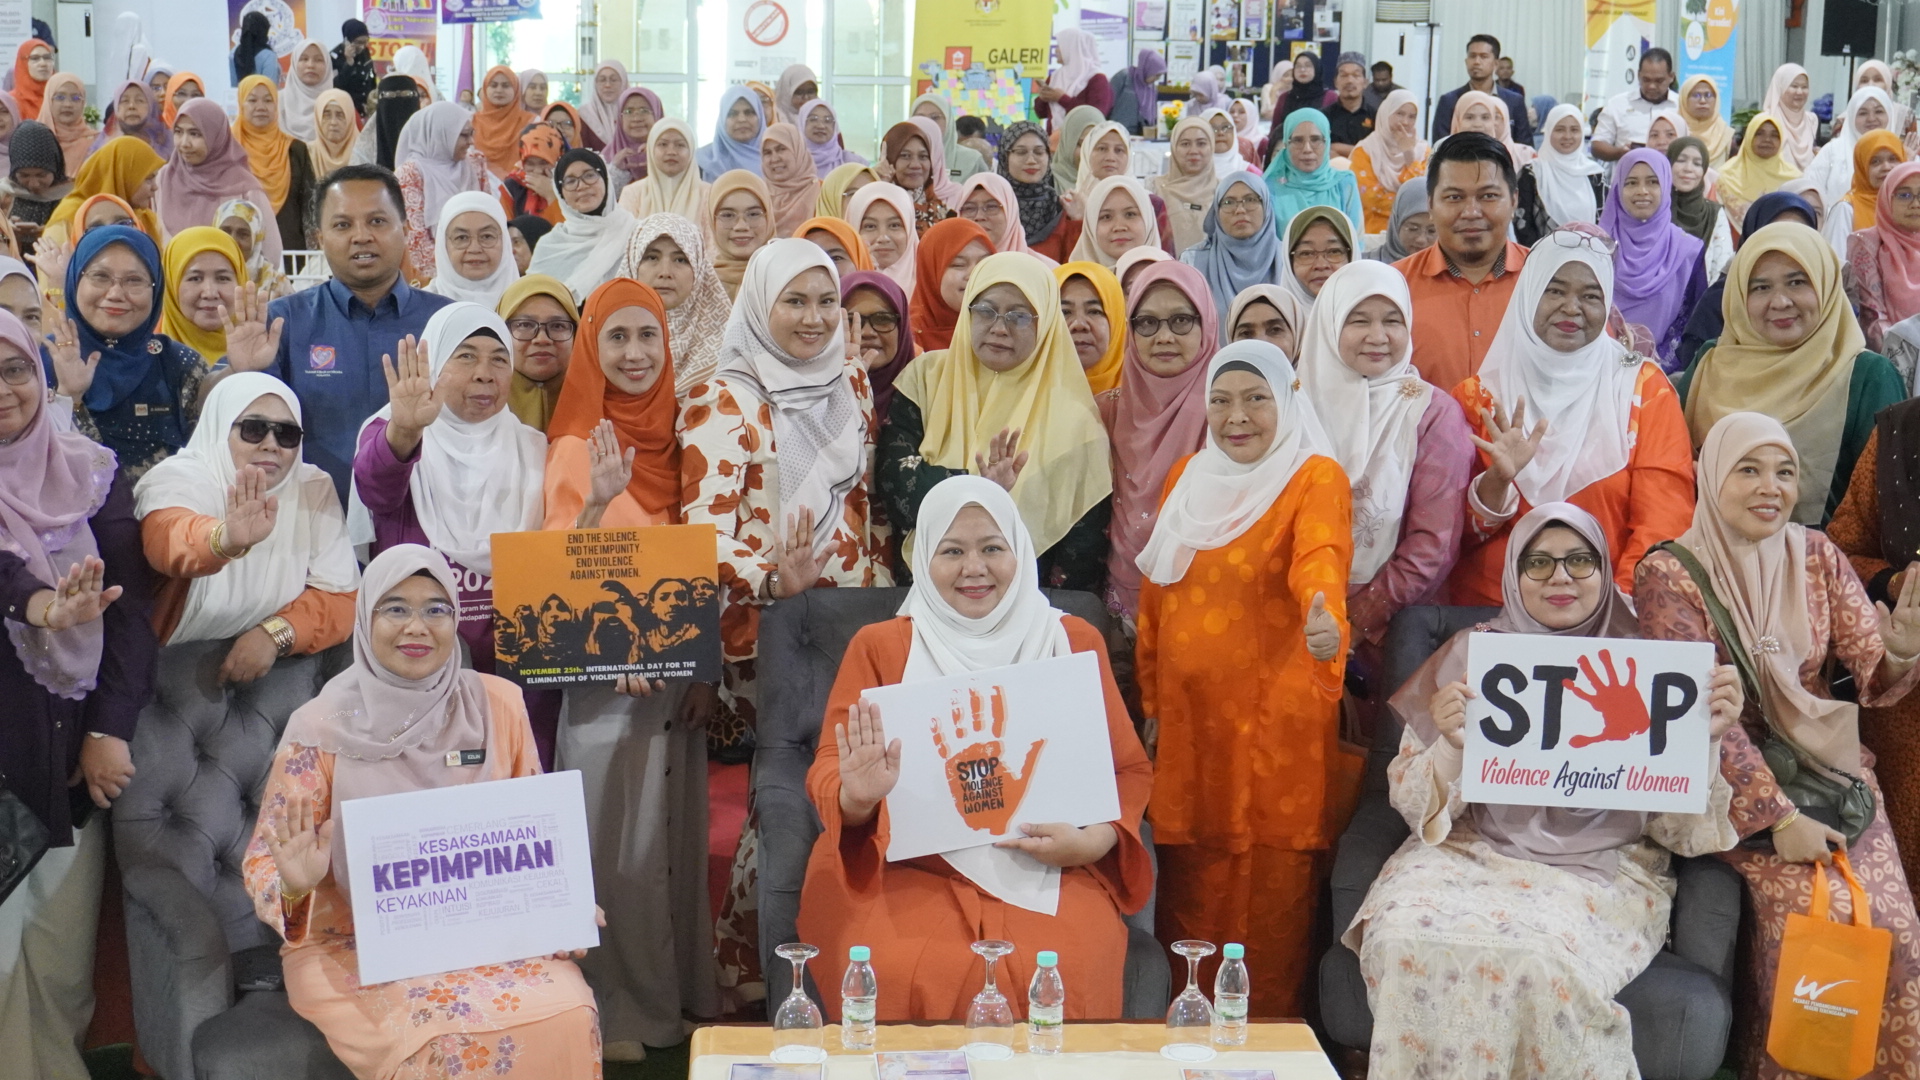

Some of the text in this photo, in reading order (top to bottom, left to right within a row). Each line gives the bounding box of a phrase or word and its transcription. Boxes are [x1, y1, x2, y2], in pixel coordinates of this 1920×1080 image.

[988, 48, 1044, 64] GALERI
[568, 532, 640, 544] END THE SILENCE.
[566, 544, 642, 556] END THE IMPUNITY.
[576, 556, 633, 568] END VIOLENCE
[570, 568, 641, 580] AGAINST WOMEN.
[520, 668, 561, 676] NOVEMBER
[586, 664, 645, 672] INTERNATIONAL
[647, 662, 663, 670] DAY
[526, 676, 576, 684] ELIMINATION
[956, 756, 1000, 782] STOP
[1481, 756, 1690, 796] Violence Against Women
[961, 776, 1003, 792] VIOLENCE
[963, 786, 1003, 802] AGAINST
[964, 798, 1004, 814] WOMEN
[419, 826, 536, 855] KESAKSAMAAN
[372, 840, 554, 892] KEPIMPINAN
[376, 886, 467, 914] KEYAKINAN
[442, 902, 472, 914] INTUISI
